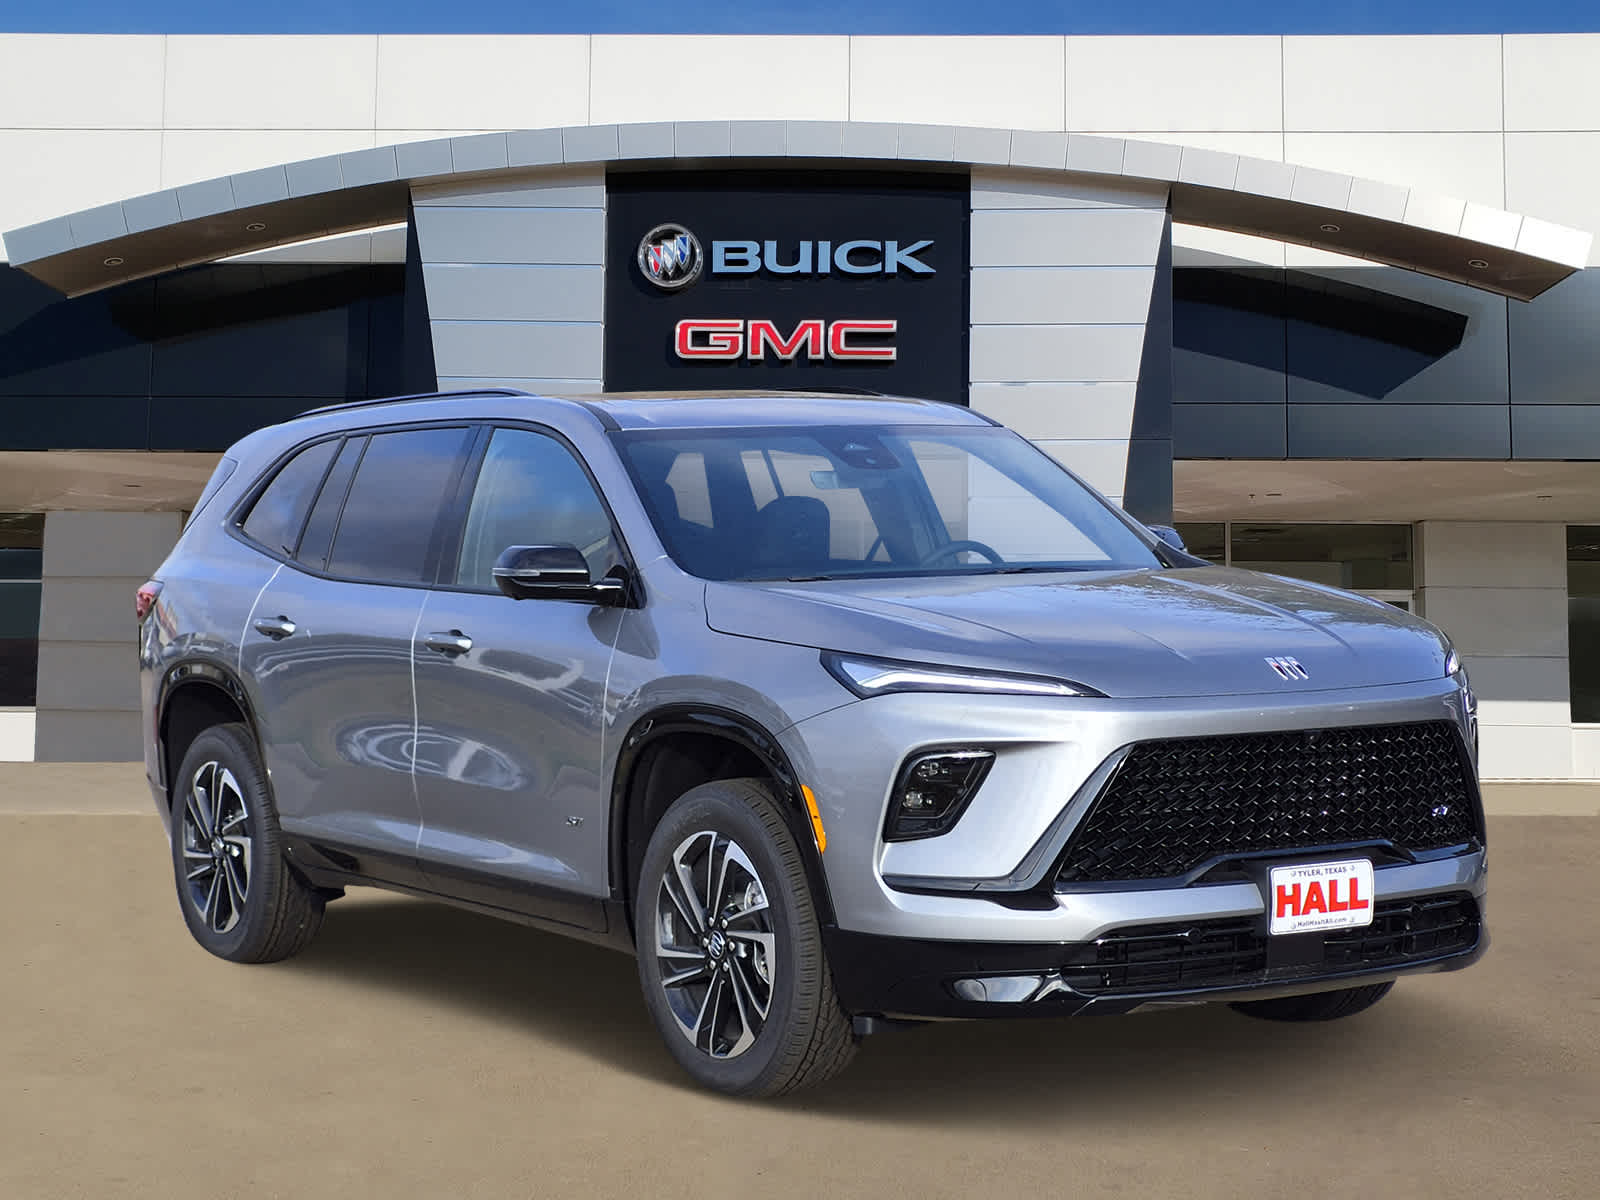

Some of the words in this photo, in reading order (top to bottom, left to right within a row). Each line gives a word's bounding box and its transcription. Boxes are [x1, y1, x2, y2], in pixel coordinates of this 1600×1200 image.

[711, 240, 936, 274] BUICK
[674, 319, 897, 360] GMC
[1298, 868, 1324, 877] TYLER,
[1325, 866, 1347, 876] TEXAS
[1276, 877, 1369, 918] HALL
